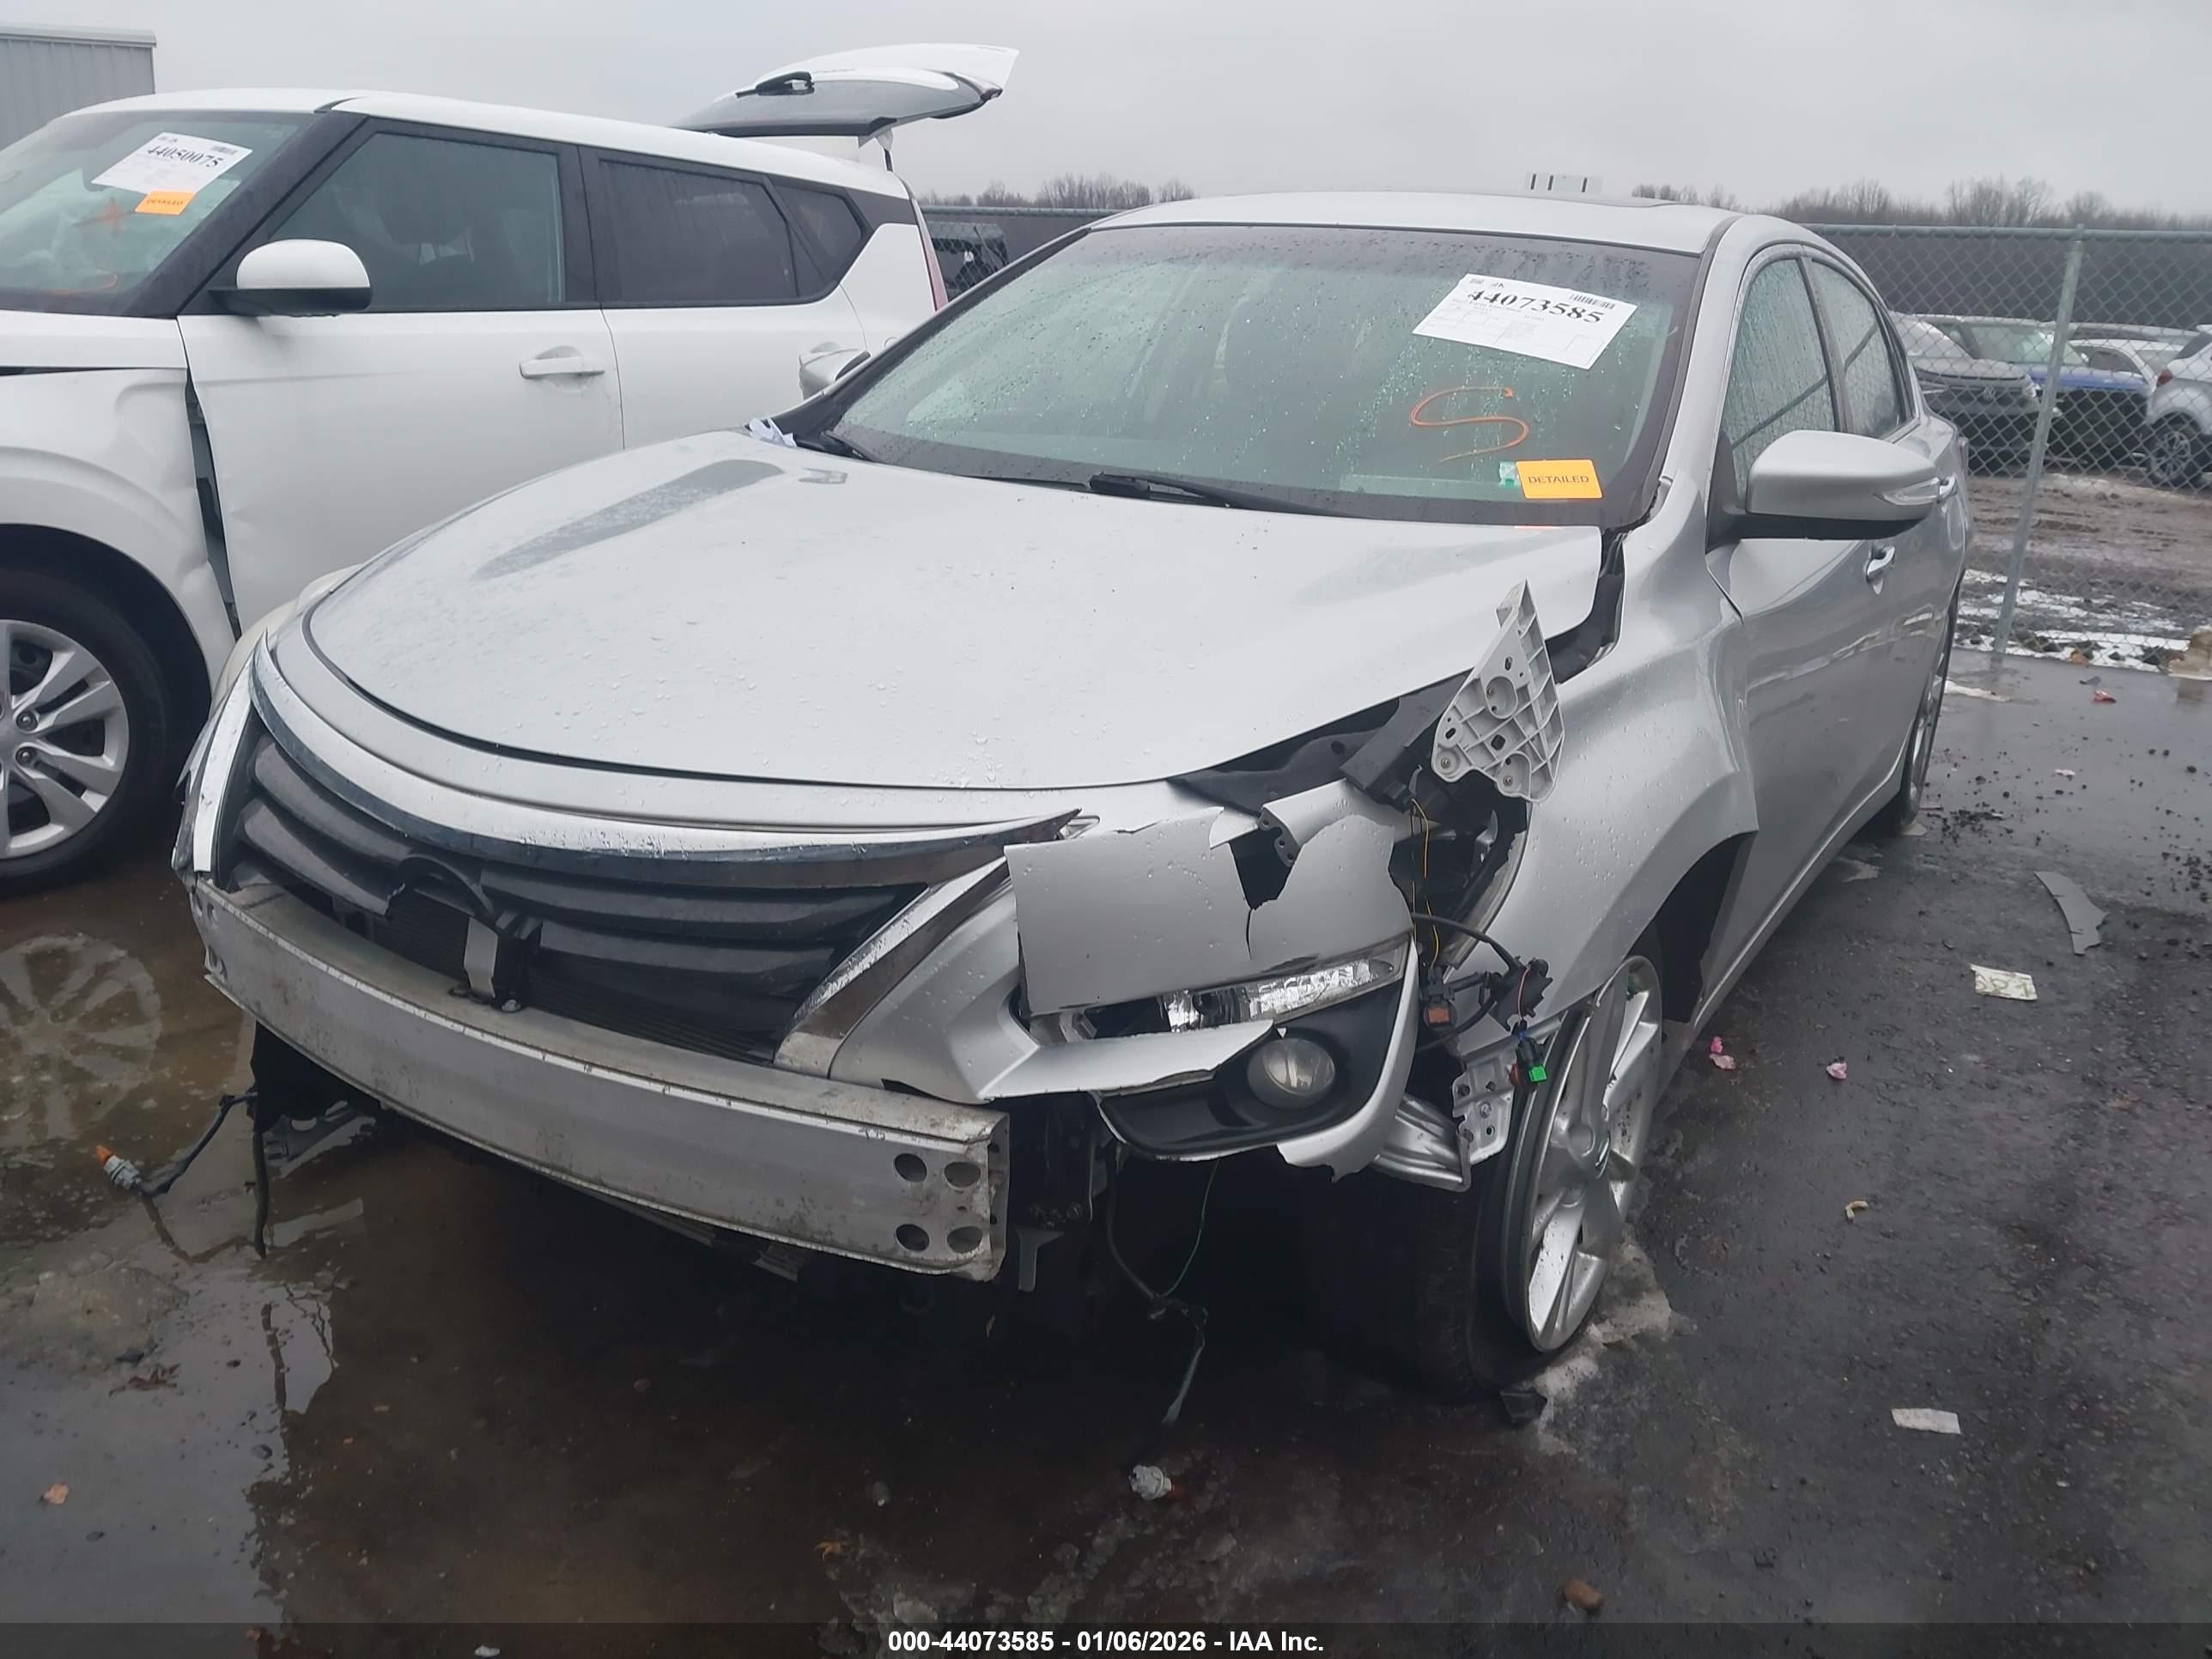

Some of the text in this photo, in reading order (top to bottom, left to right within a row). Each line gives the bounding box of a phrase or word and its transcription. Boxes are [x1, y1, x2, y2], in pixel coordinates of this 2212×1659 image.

[148, 145, 224, 168] 44050075
[1468, 289, 1605, 324] 44073585
[1528, 475, 1589, 484] DETAILED
